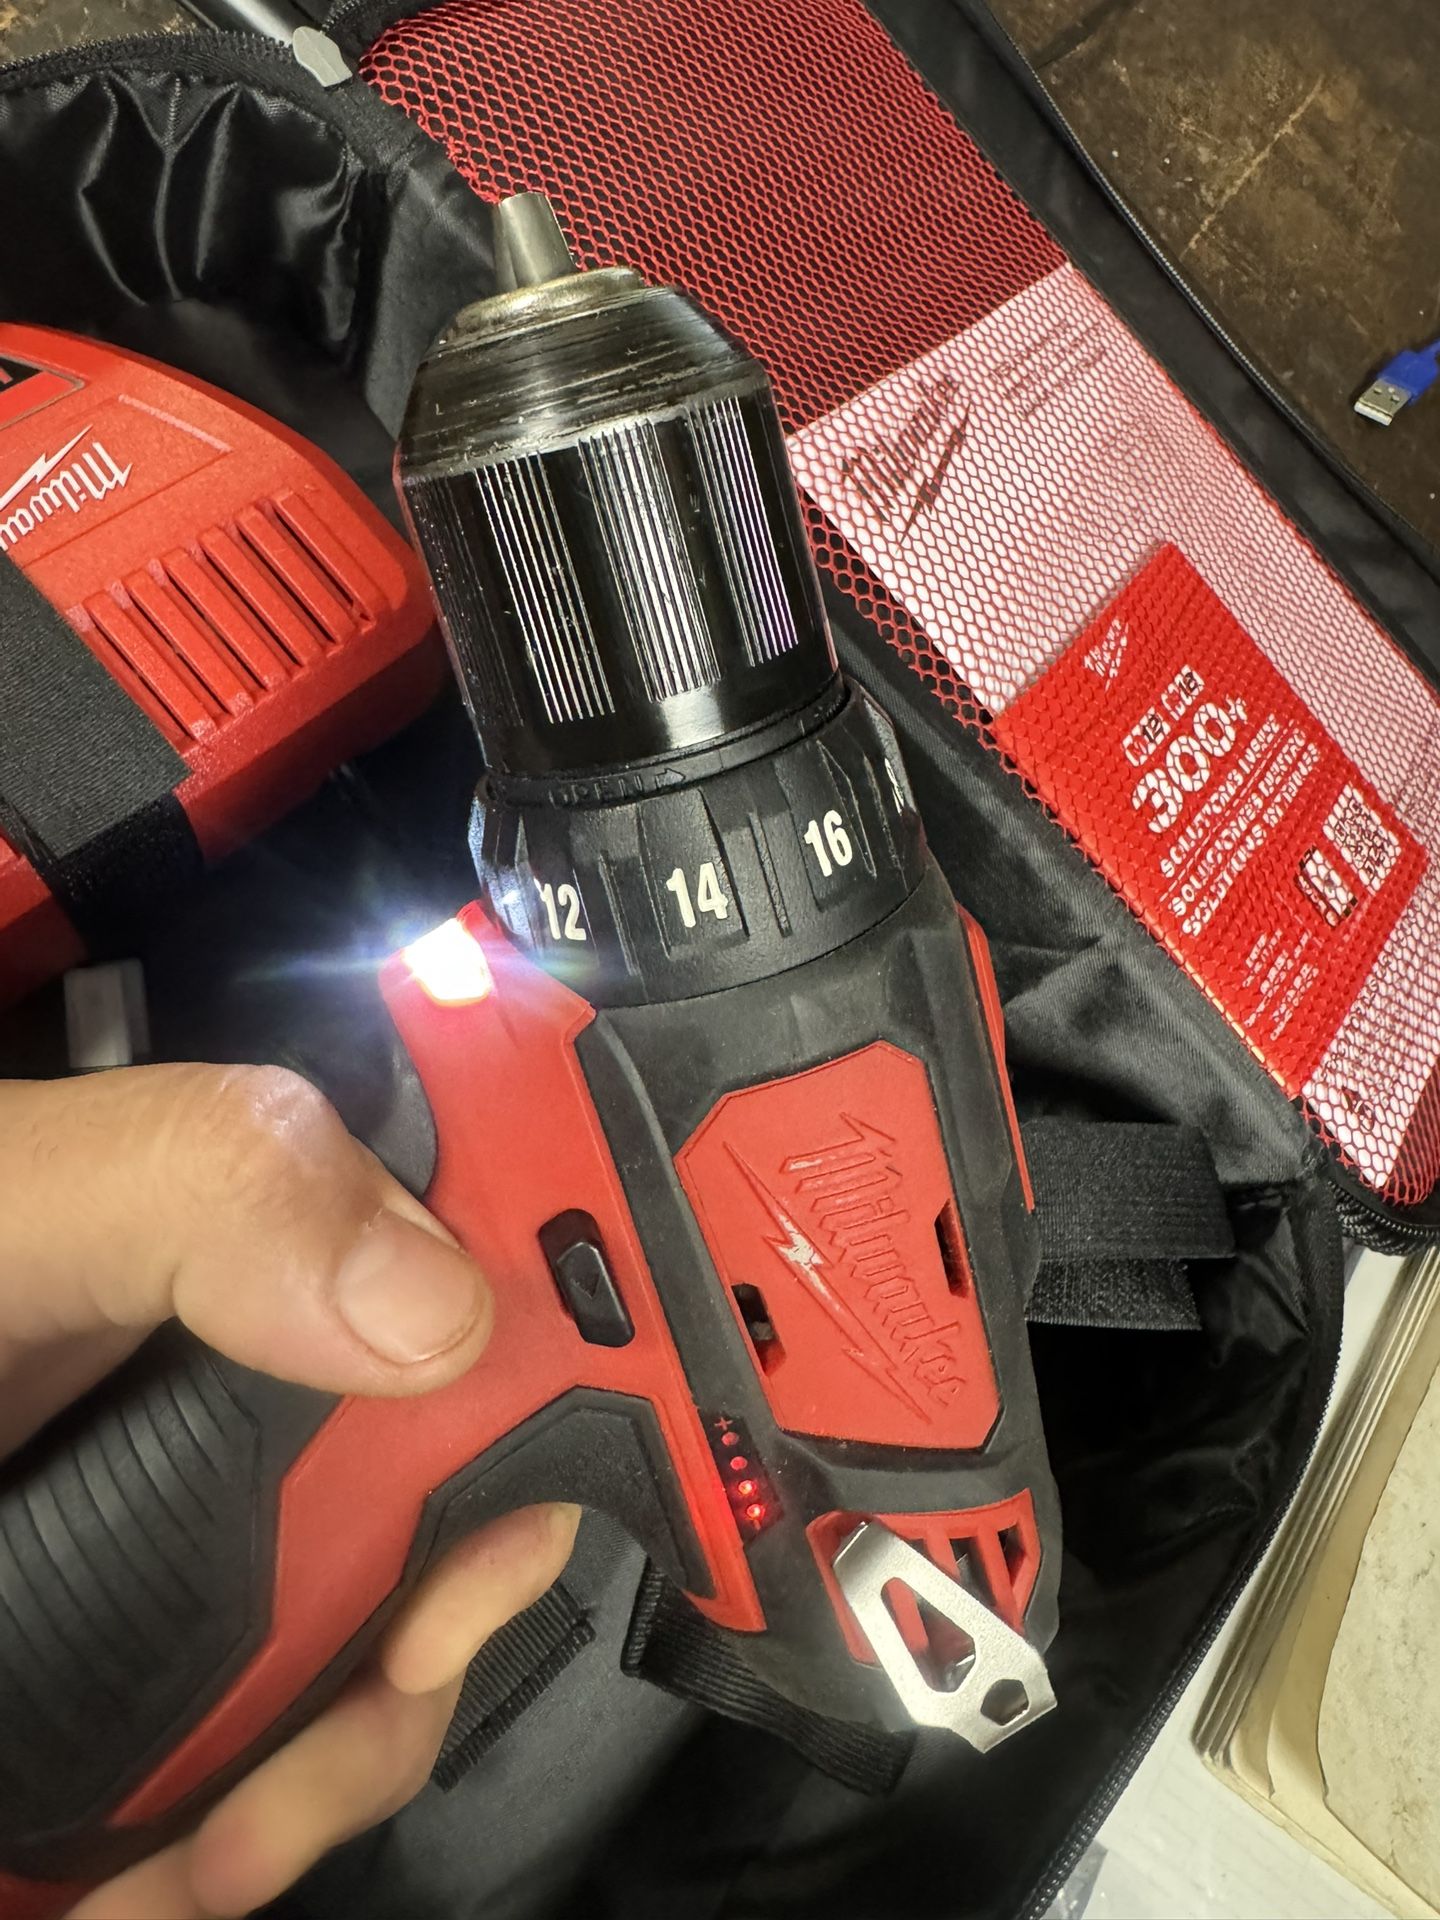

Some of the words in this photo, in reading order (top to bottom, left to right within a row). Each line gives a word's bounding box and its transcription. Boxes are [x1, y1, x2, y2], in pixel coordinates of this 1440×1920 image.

[1131, 694, 1248, 834] 300+
[538, 882, 587, 940] 12
[666, 862, 729, 928] 14
[803, 809, 853, 877] 16
[779, 1112, 967, 1407] Milwaukee
